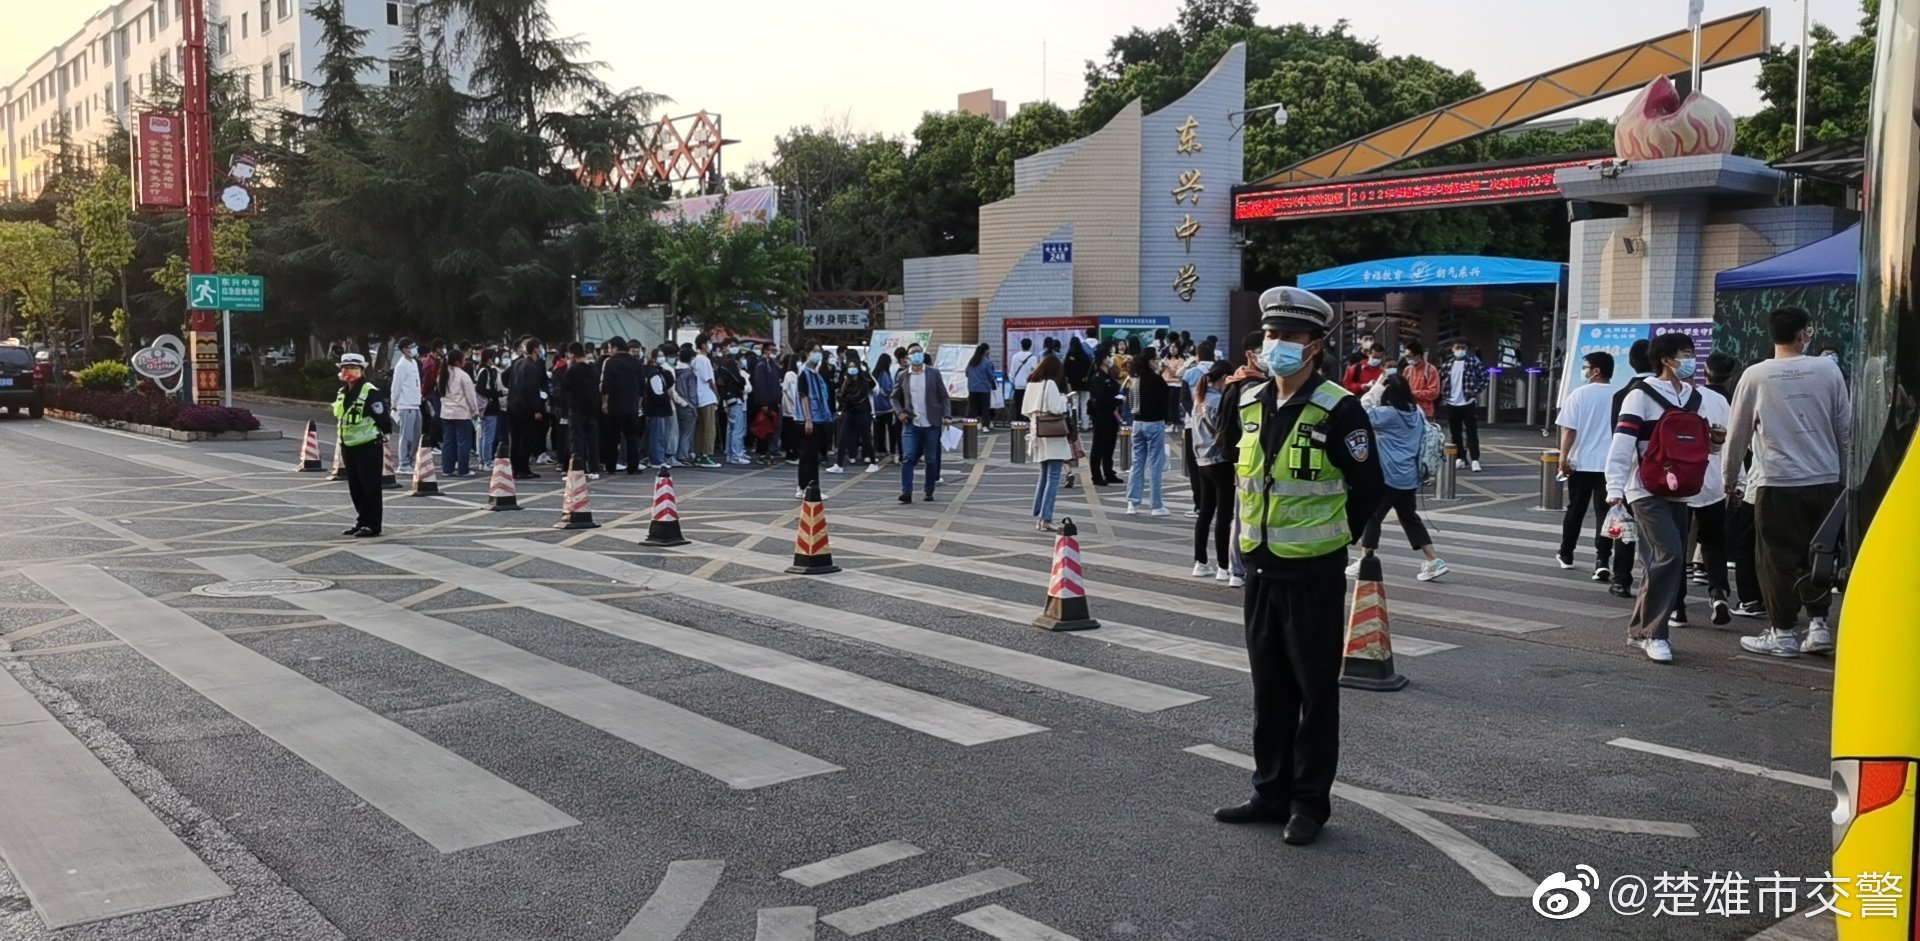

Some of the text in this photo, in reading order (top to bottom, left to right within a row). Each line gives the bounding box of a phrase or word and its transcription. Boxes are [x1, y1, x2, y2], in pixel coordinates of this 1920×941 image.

[1171, 115, 1204, 302] 东兴中学
[1362, 269, 1404, 282] 幸福教育
[221, 278, 260, 287] 东兴中学
[814, 313, 860, 325] 修身明志
[1279, 502, 1332, 521] POLICE
